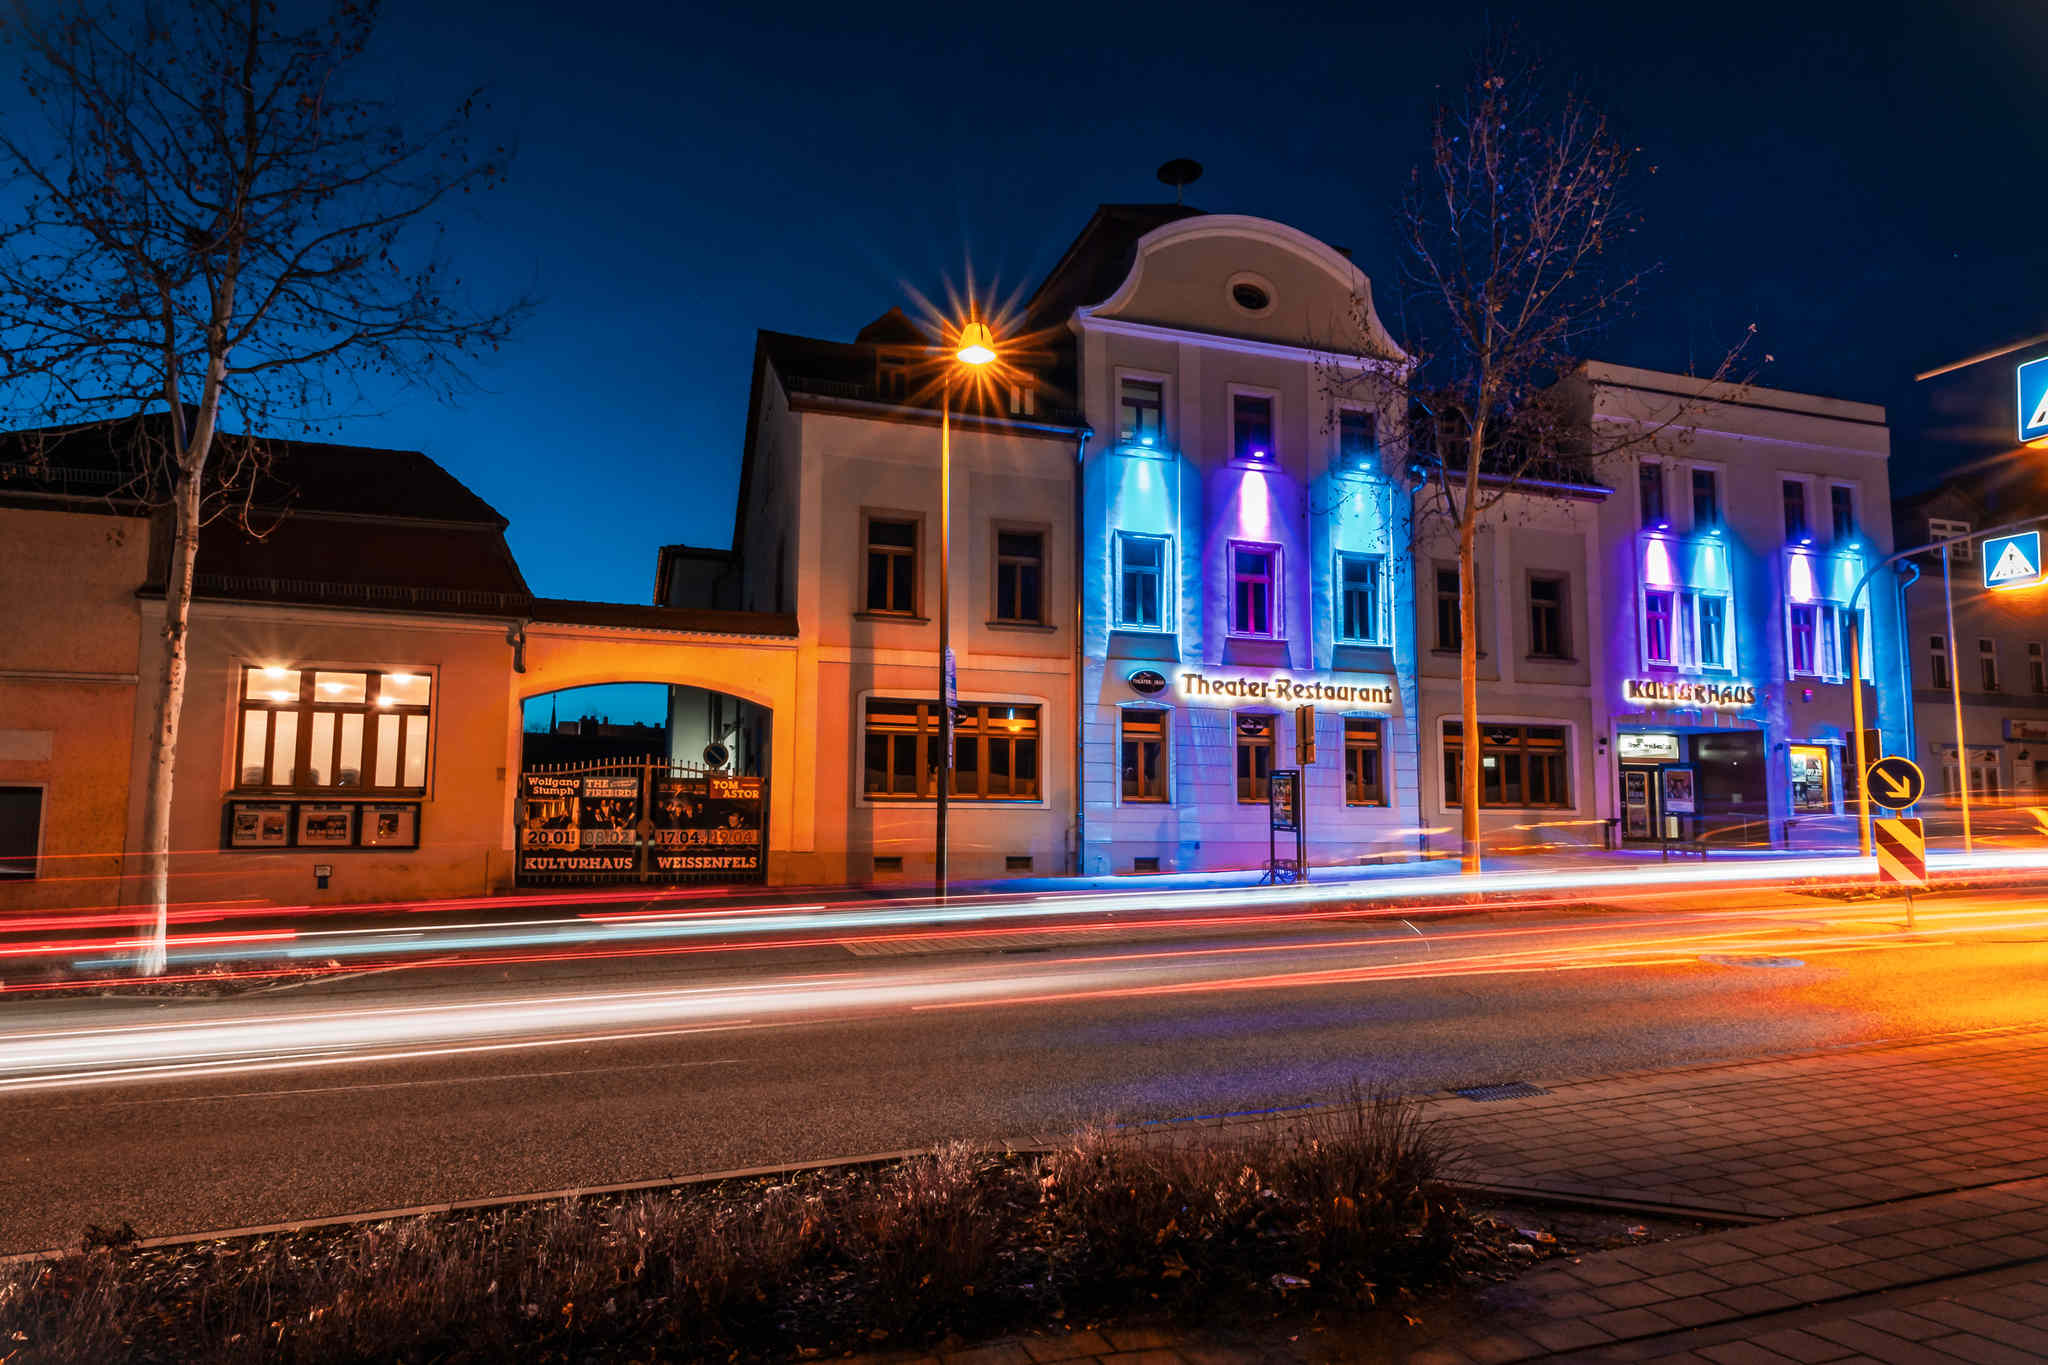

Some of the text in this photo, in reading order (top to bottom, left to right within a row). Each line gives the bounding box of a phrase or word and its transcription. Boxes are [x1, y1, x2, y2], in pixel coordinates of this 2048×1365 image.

[1182, 673, 1392, 704] Theater-Restaurant
[1629, 679, 1755, 706] KULTURHAUS
[528, 777, 580, 788] Wolfgang
[585, 779, 609, 788] THE
[712, 780, 739, 789] TOM
[532, 786, 575, 796] Stumph
[585, 789, 638, 798] FIREBIRDS
[722, 790, 760, 799] ASTOR
[524, 857, 633, 870] KULTURHAUS
[656, 856, 758, 869] WEISSENFELS
